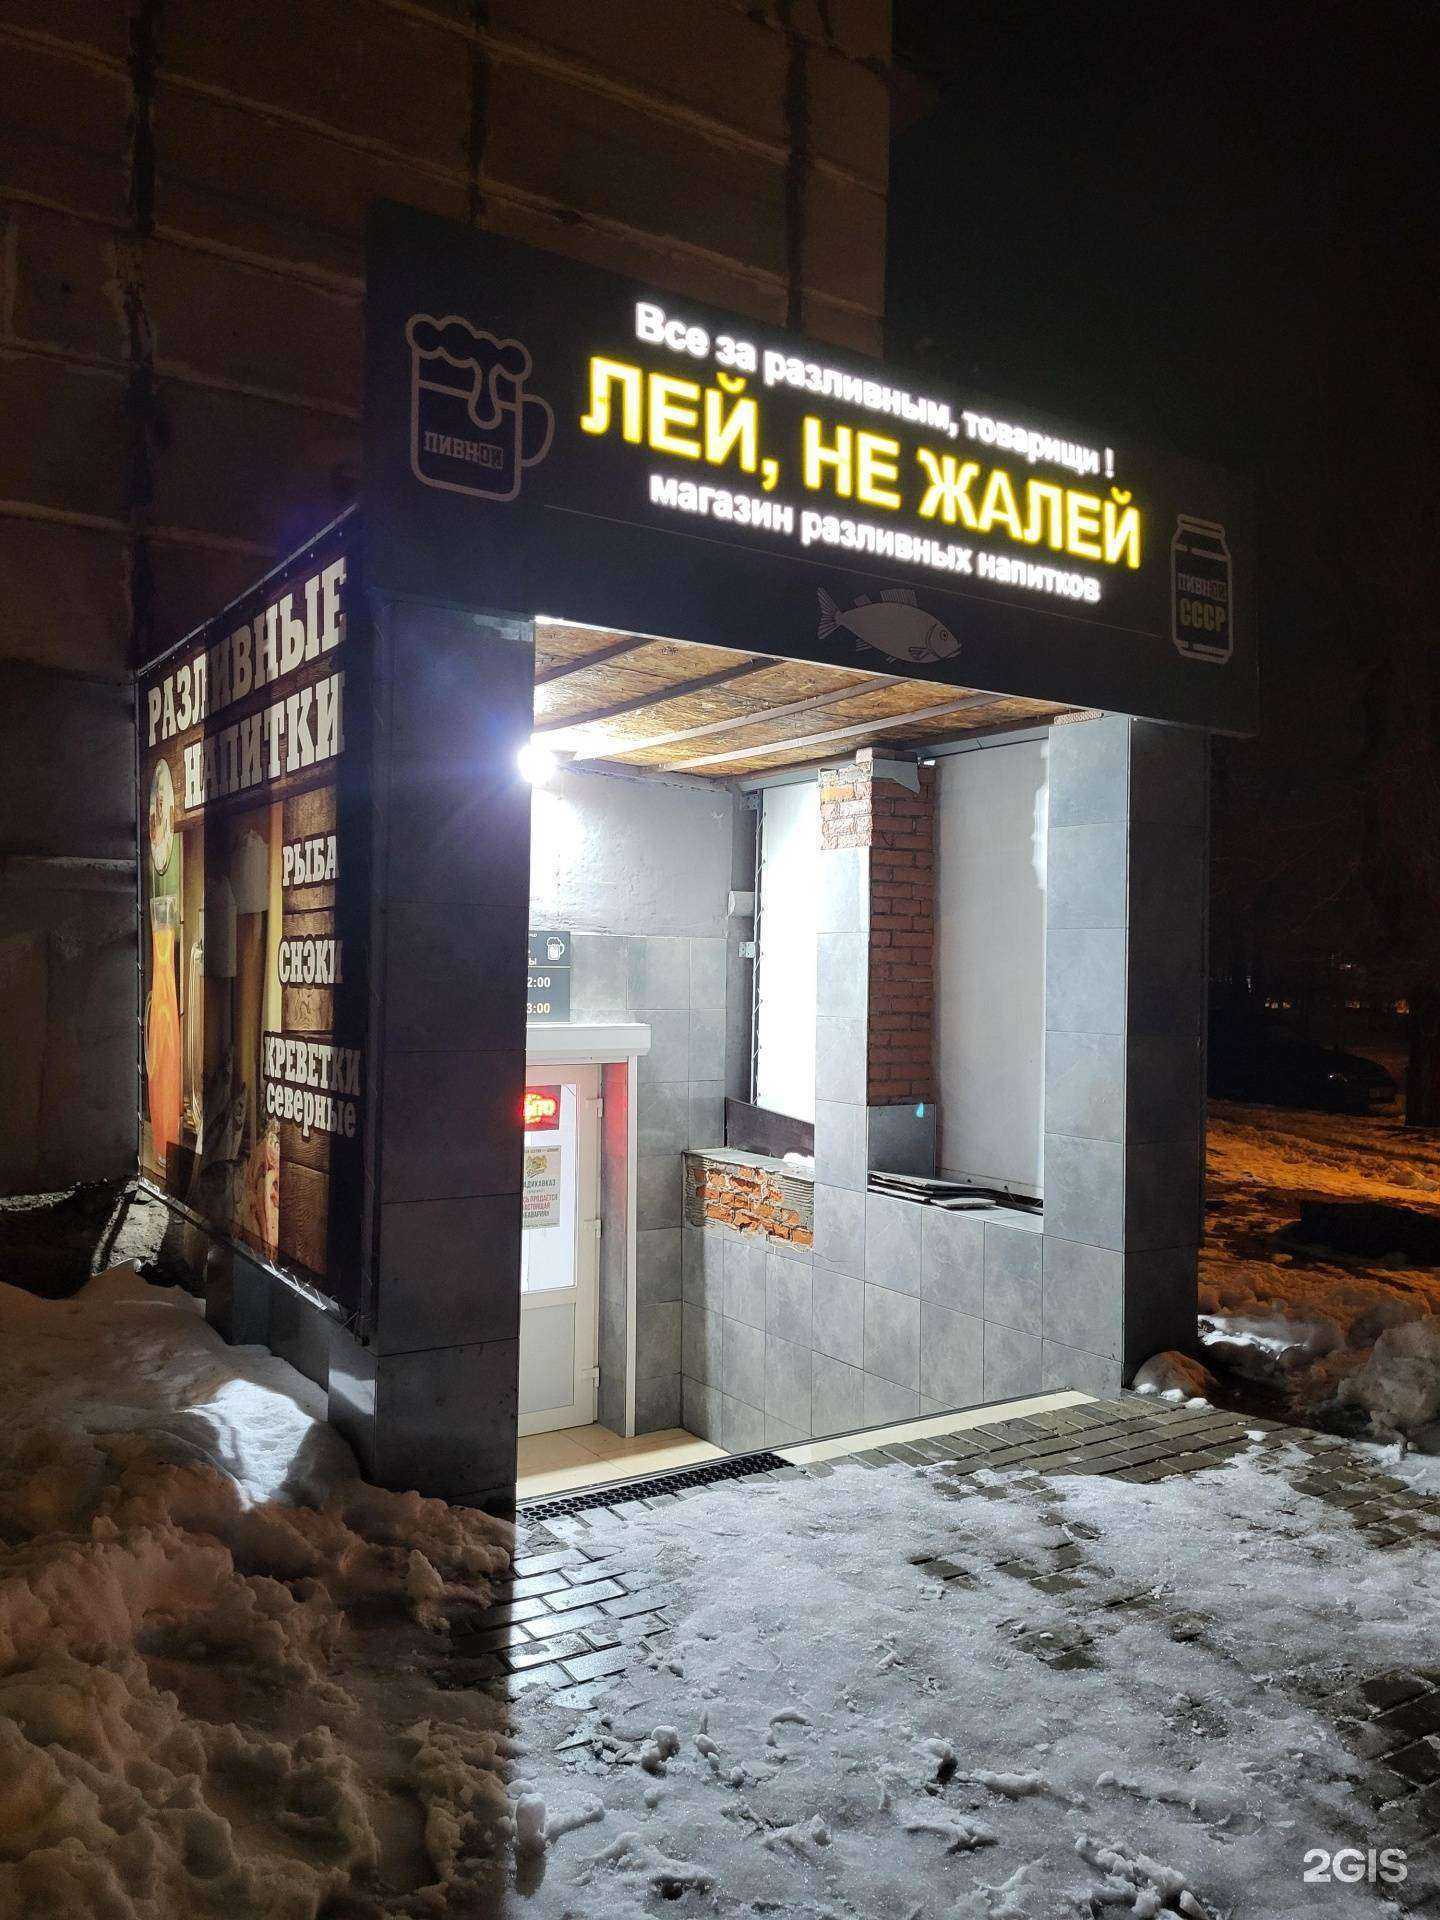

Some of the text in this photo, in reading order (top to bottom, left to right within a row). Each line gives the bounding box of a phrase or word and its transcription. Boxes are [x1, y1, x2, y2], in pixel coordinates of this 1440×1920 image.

[636, 302, 709, 357] Все
[716, 332, 756, 372] за
[763, 350, 957, 437] разливным,
[962, 408, 1099, 475] товарищи
[580, 355, 1141, 569] ЛЕЙ, НЕ ЖАЛЕЙ
[650, 475, 1100, 602] магазин разливных напитков
[1179, 598, 1226, 632] СССР
[148, 556, 347, 747] РАЗЛИВНЫЕ
[184, 670, 345, 810] НАПИТКИ
[282, 835, 339, 887] РЫБА
[278, 937, 343, 985] СНЭКИ
[527, 976, 551, 988] 2:00
[264, 1035, 361, 1095] КРЕВЕТКИ
[266, 1084, 356, 1138] северные
